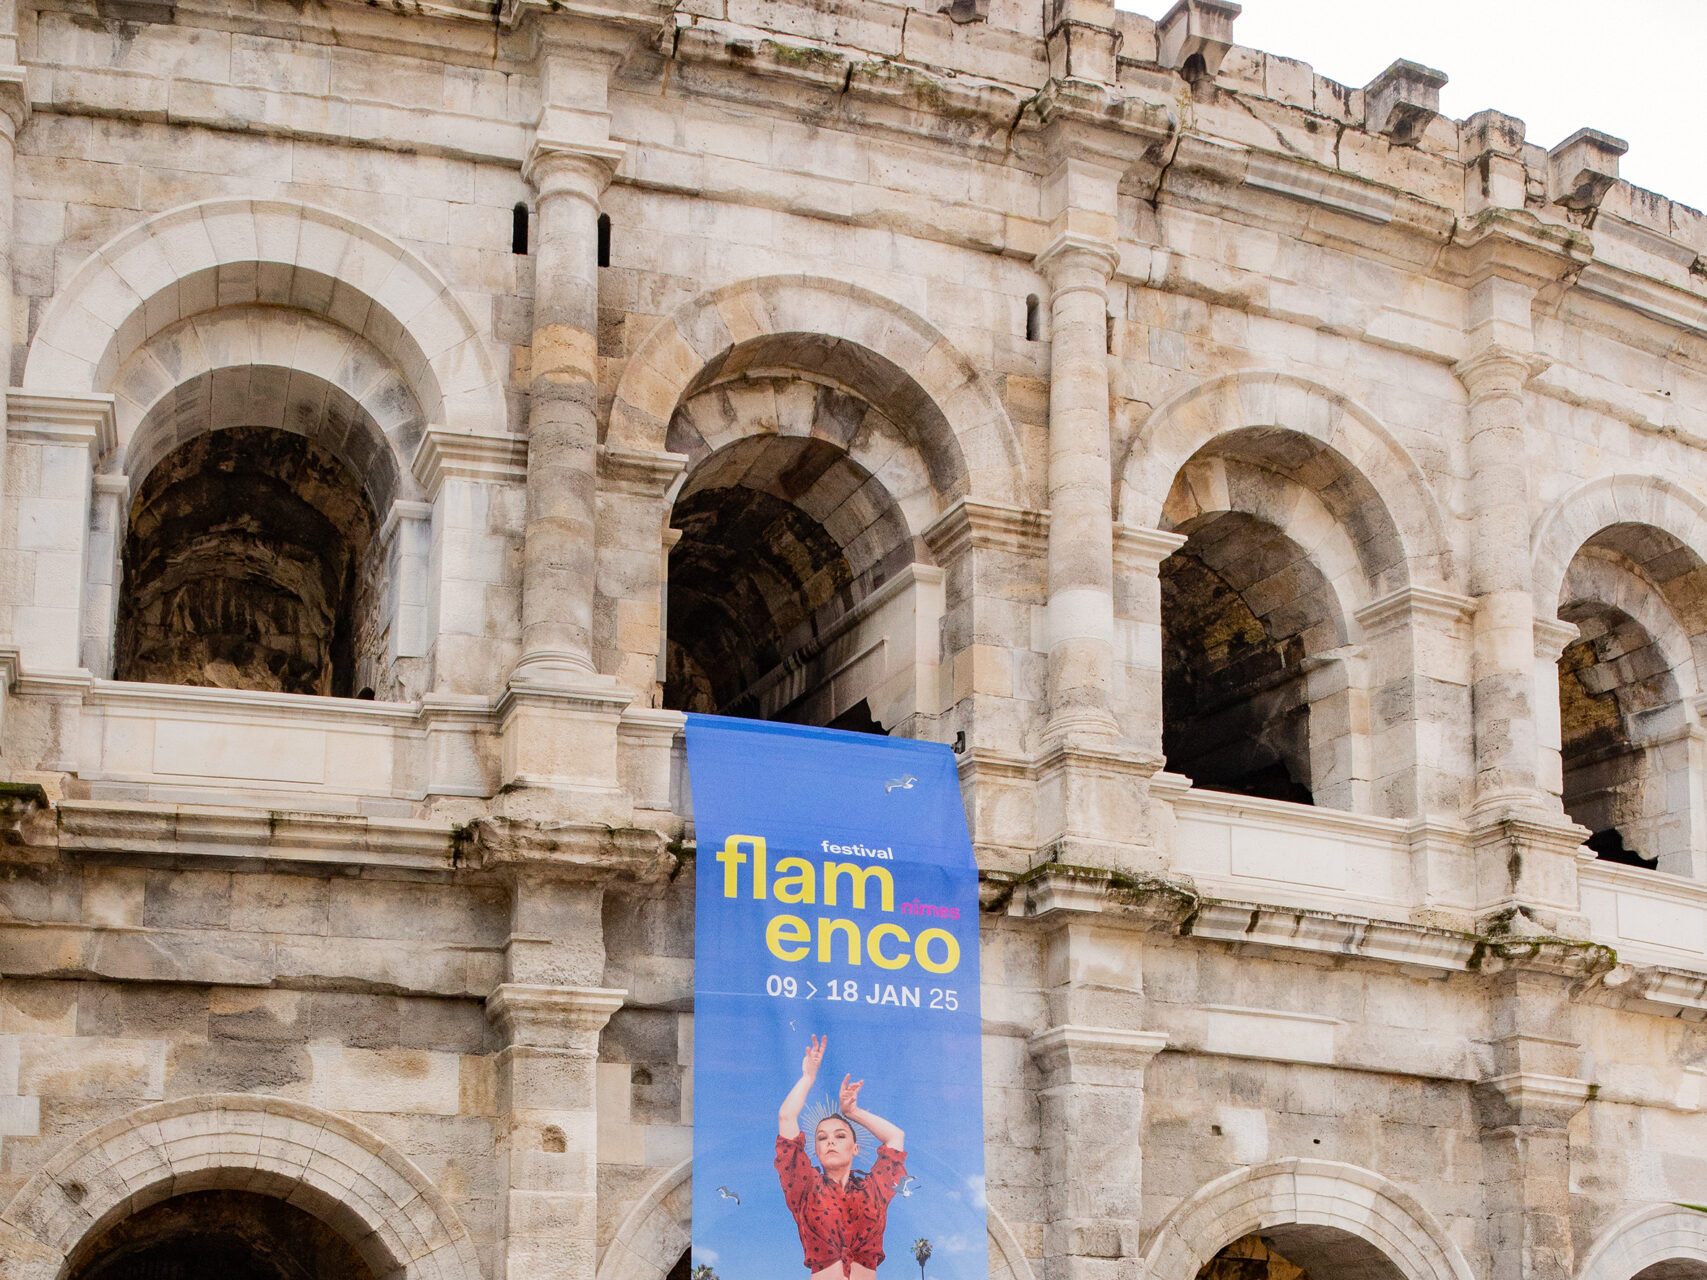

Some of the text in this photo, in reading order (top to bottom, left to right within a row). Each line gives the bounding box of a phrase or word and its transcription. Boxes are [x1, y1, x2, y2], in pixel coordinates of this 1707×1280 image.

[821, 840, 893, 860] festival
[716, 834, 894, 912] flam
[901, 898, 961, 921] nîmes
[765, 914, 961, 973] enco
[766, 974, 798, 998] 09
[826, 979, 858, 1003] 18
[866, 983, 920, 1008] JAN
[929, 988, 959, 1011] 25
